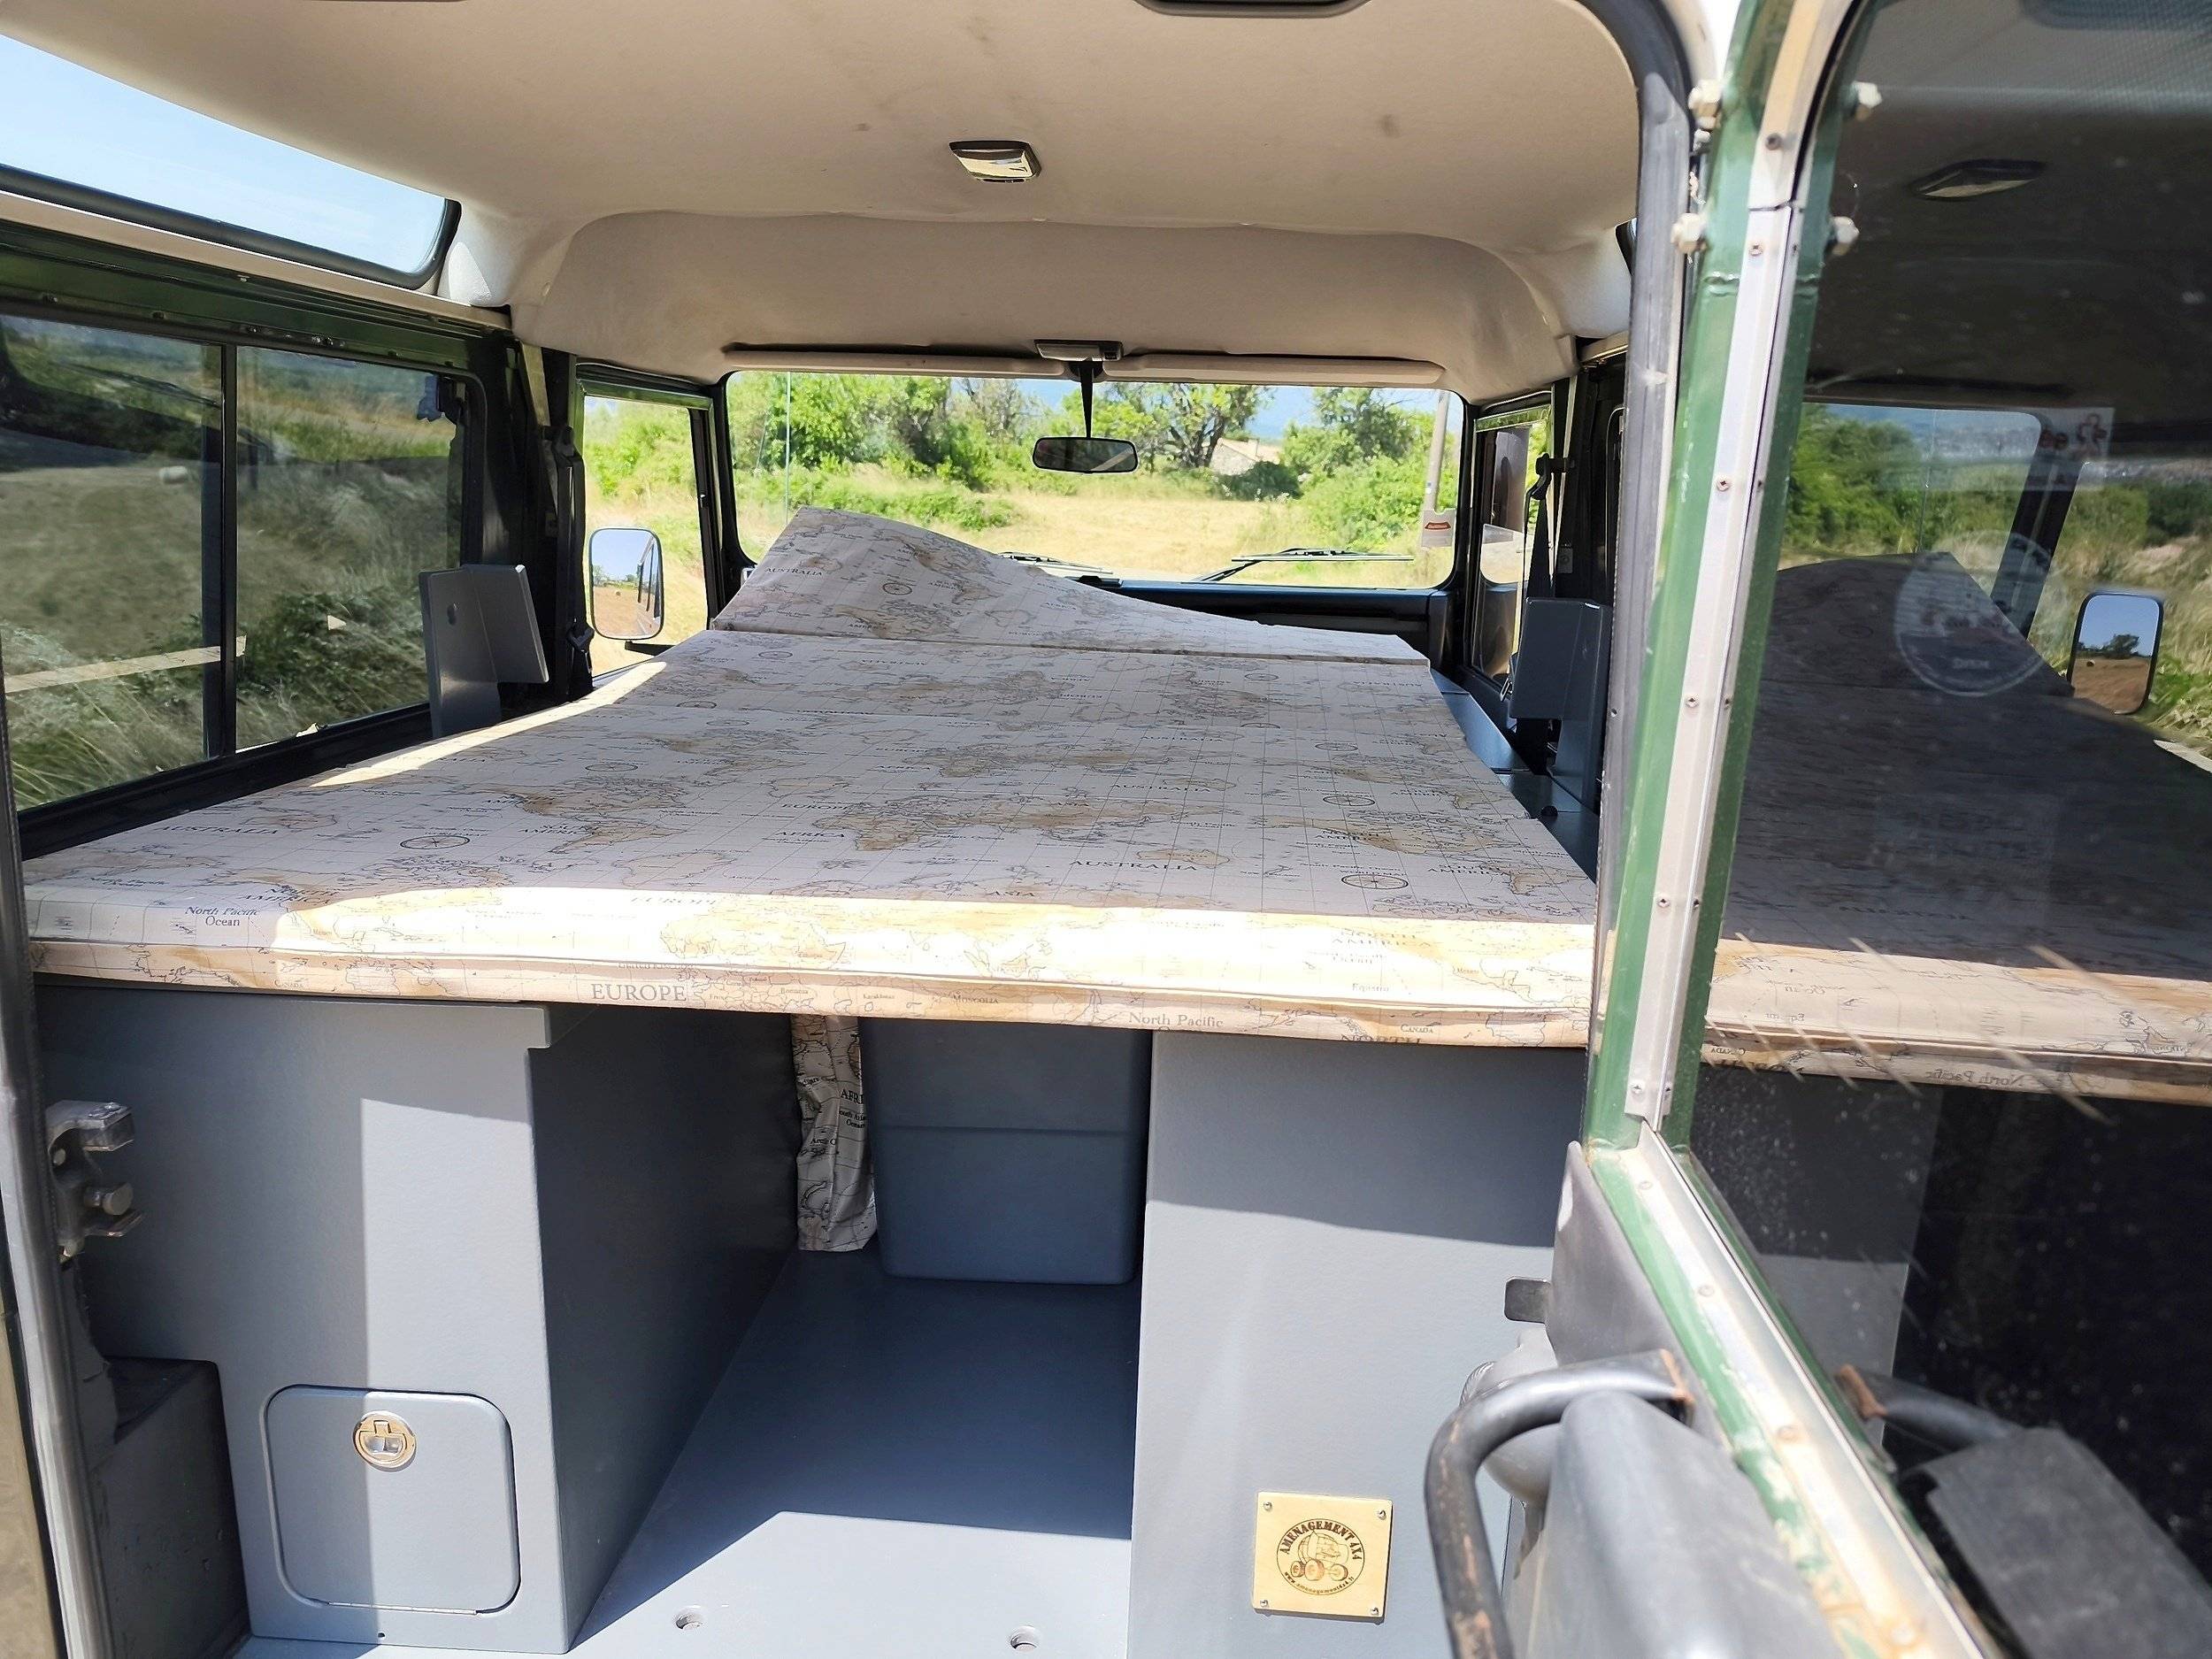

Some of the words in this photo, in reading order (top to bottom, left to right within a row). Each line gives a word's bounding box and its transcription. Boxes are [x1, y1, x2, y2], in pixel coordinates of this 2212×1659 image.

[764, 567, 823, 576] AUSTRALIA
[156, 825, 279, 834] AUSTRALIA
[1069, 860, 1197, 871] AUSTRALIA
[239, 893, 331, 904] AMERICA
[184, 905, 219, 917] North
[223, 907, 260, 918] Pacific
[204, 916, 241, 927] Ocean
[591, 983, 687, 1002] EUROPE
[1128, 1011, 1171, 1027] North
[1176, 1013, 1225, 1029] Pacific
[1279, 1520, 1355, 1555] AMENAGEMENT
